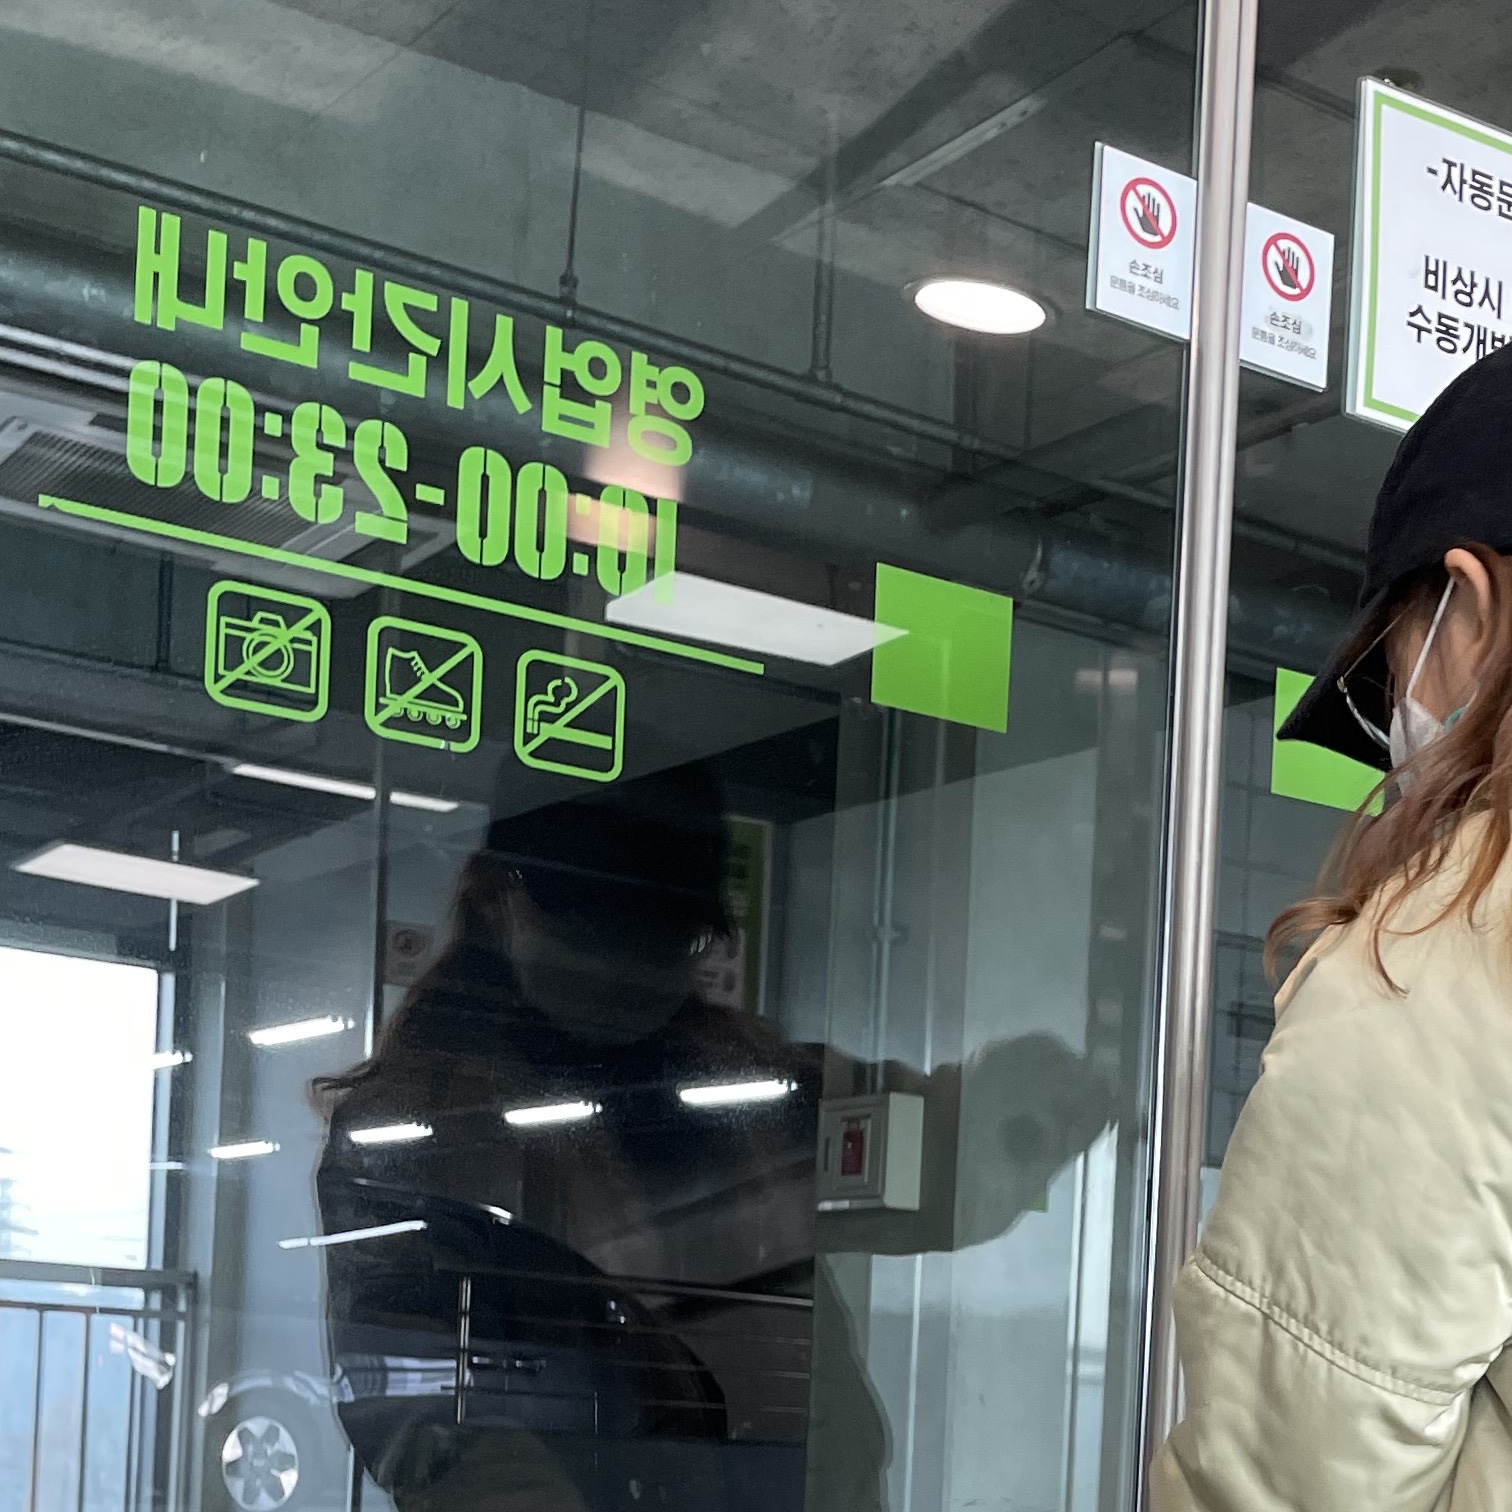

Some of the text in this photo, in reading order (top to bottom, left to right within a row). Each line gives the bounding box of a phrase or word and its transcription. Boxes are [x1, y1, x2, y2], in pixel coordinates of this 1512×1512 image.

[1128, 259, 1164, 285] 손조심
[1424, 255, 1503, 319] 비상시
[1270, 311, 1302, 335] 손조심
